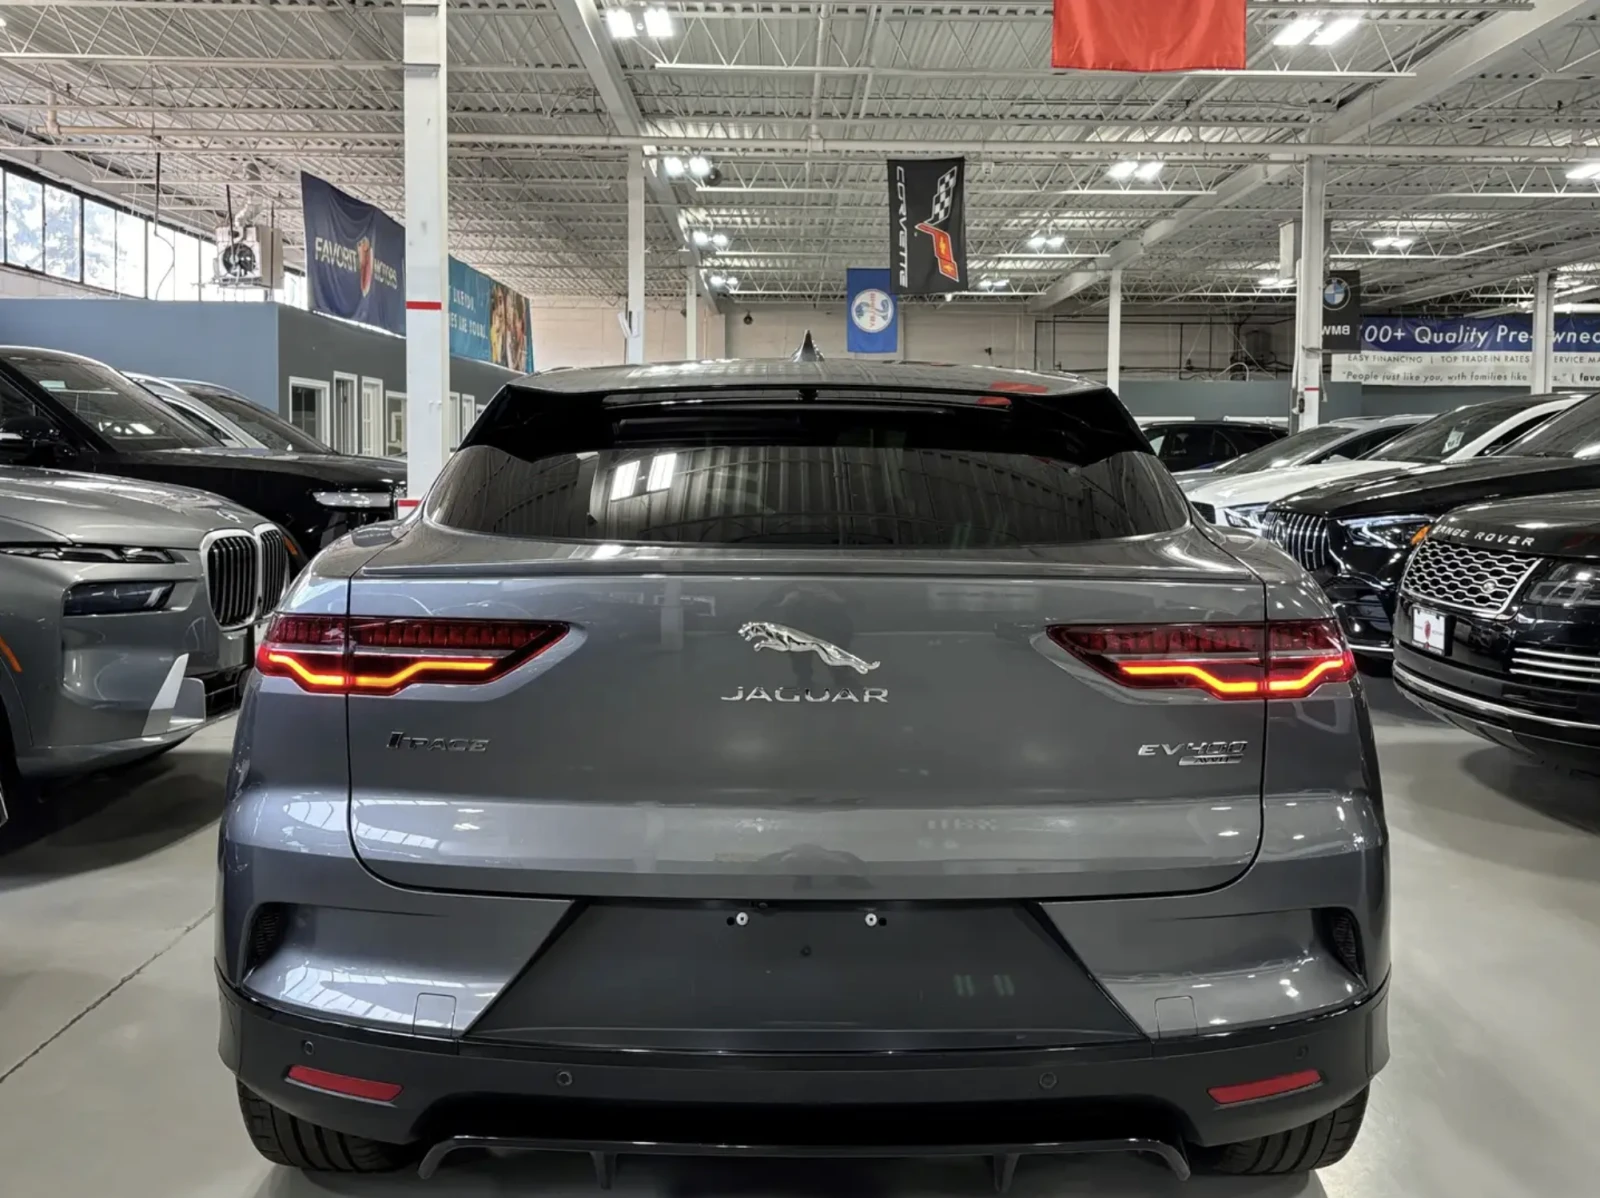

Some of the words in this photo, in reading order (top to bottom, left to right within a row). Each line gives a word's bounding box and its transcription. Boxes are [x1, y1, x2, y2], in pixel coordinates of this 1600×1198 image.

[896, 165, 909, 288] CORVETTE
[315, 236, 357, 272] FAVORIT
[1359, 325, 1405, 343] 00+
[1414, 325, 1488, 348] Quality
[1372, 355, 1423, 363] FINANCING
[1504, 355, 1530, 363] RATES
[1382, 373, 1400, 381] just
[1403, 372, 1420, 381] like
[1447, 372, 1467, 381] with
[1470, 371, 1508, 381] families
[1511, 371, 1528, 381] like
[1474, 531, 1535, 546] ROVER
[720, 686, 889, 703] JAGUAR
[1138, 741, 1248, 756] EV400
